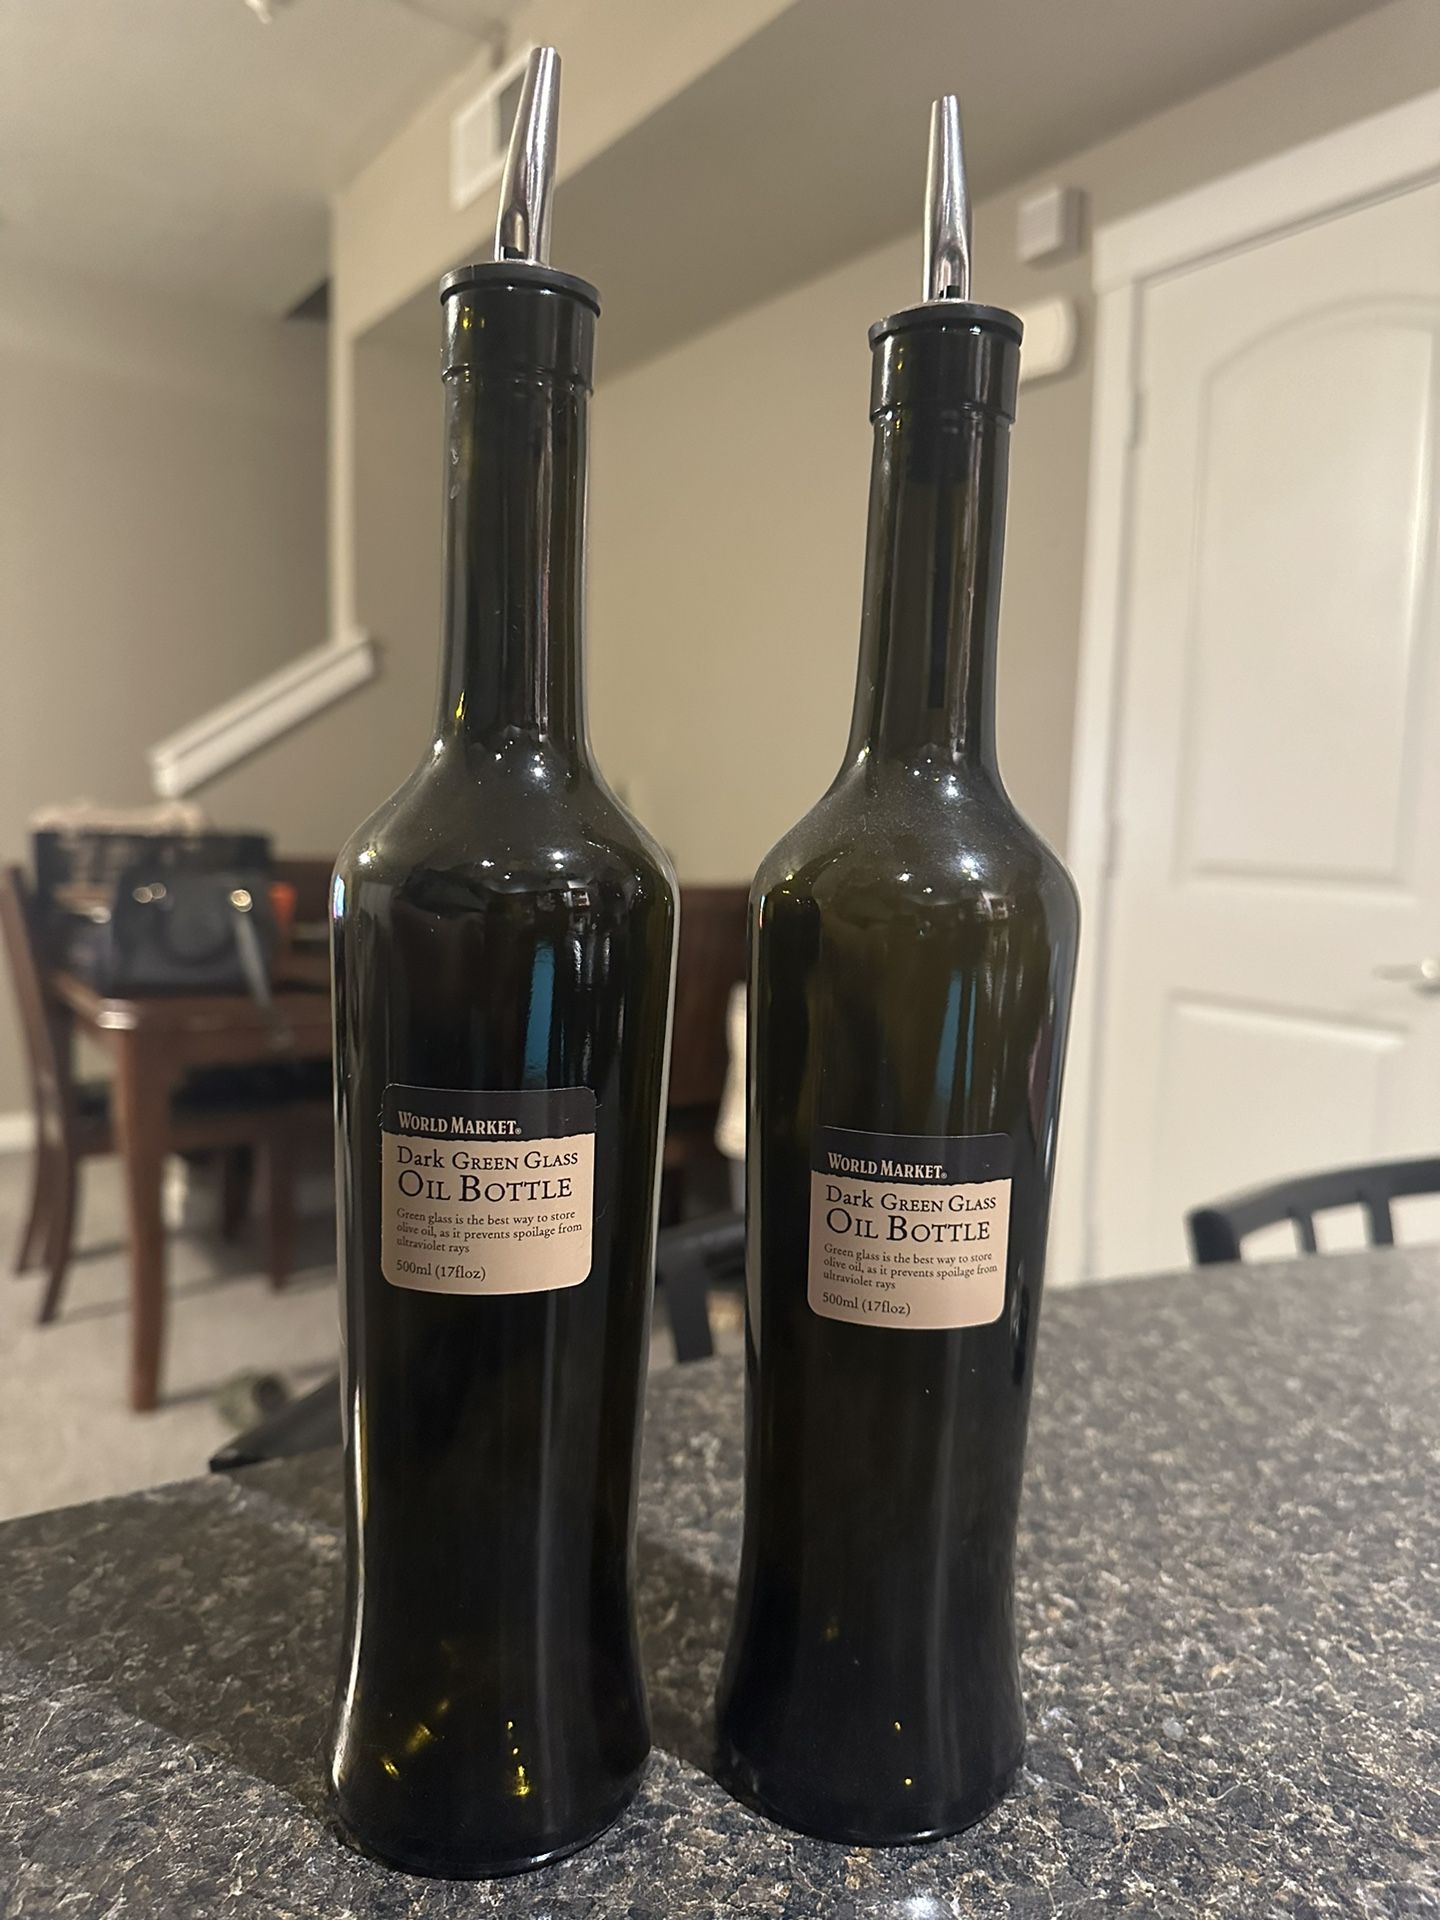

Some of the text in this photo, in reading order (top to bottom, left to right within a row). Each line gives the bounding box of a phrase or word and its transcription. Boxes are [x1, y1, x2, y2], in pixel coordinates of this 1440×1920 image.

[398, 1111, 448, 1133] WORLD
[397, 1146, 578, 1170] Dark GREEN GLASS
[828, 1152, 877, 1174] WORLD
[399, 1170, 572, 1202] OIL BOTTLE
[825, 1185, 996, 1212] Dark GREEN GLASS
[397, 1208, 575, 1226] Green glass is the best way to store
[827, 1208, 990, 1242] OIL BOTTLE
[397, 1223, 418, 1234] olive
[421, 1226, 437, 1237] oil,
[453, 1230, 460, 1239] it
[464, 1231, 510, 1242] prevents
[513, 1226, 555, 1241] spoilage
[558, 1222, 582, 1234] from
[396, 1237, 469, 1254] ultraviolet rays
[824, 1243, 992, 1266] Green glass is the best way to store
[396, 1260, 486, 1282] 500ml (17floz)
[824, 1258, 846, 1270] olive
[848, 1263, 864, 1273] oil,
[880, 1266, 887, 1275] it
[891, 1268, 934, 1279] prevents
[937, 1267, 974, 1280] spoilage
[977, 1264, 998, 1274] from
[823, 1271, 896, 1290] ultraviolet rays
[823, 1292, 911, 1315] 500ml (17floz)
